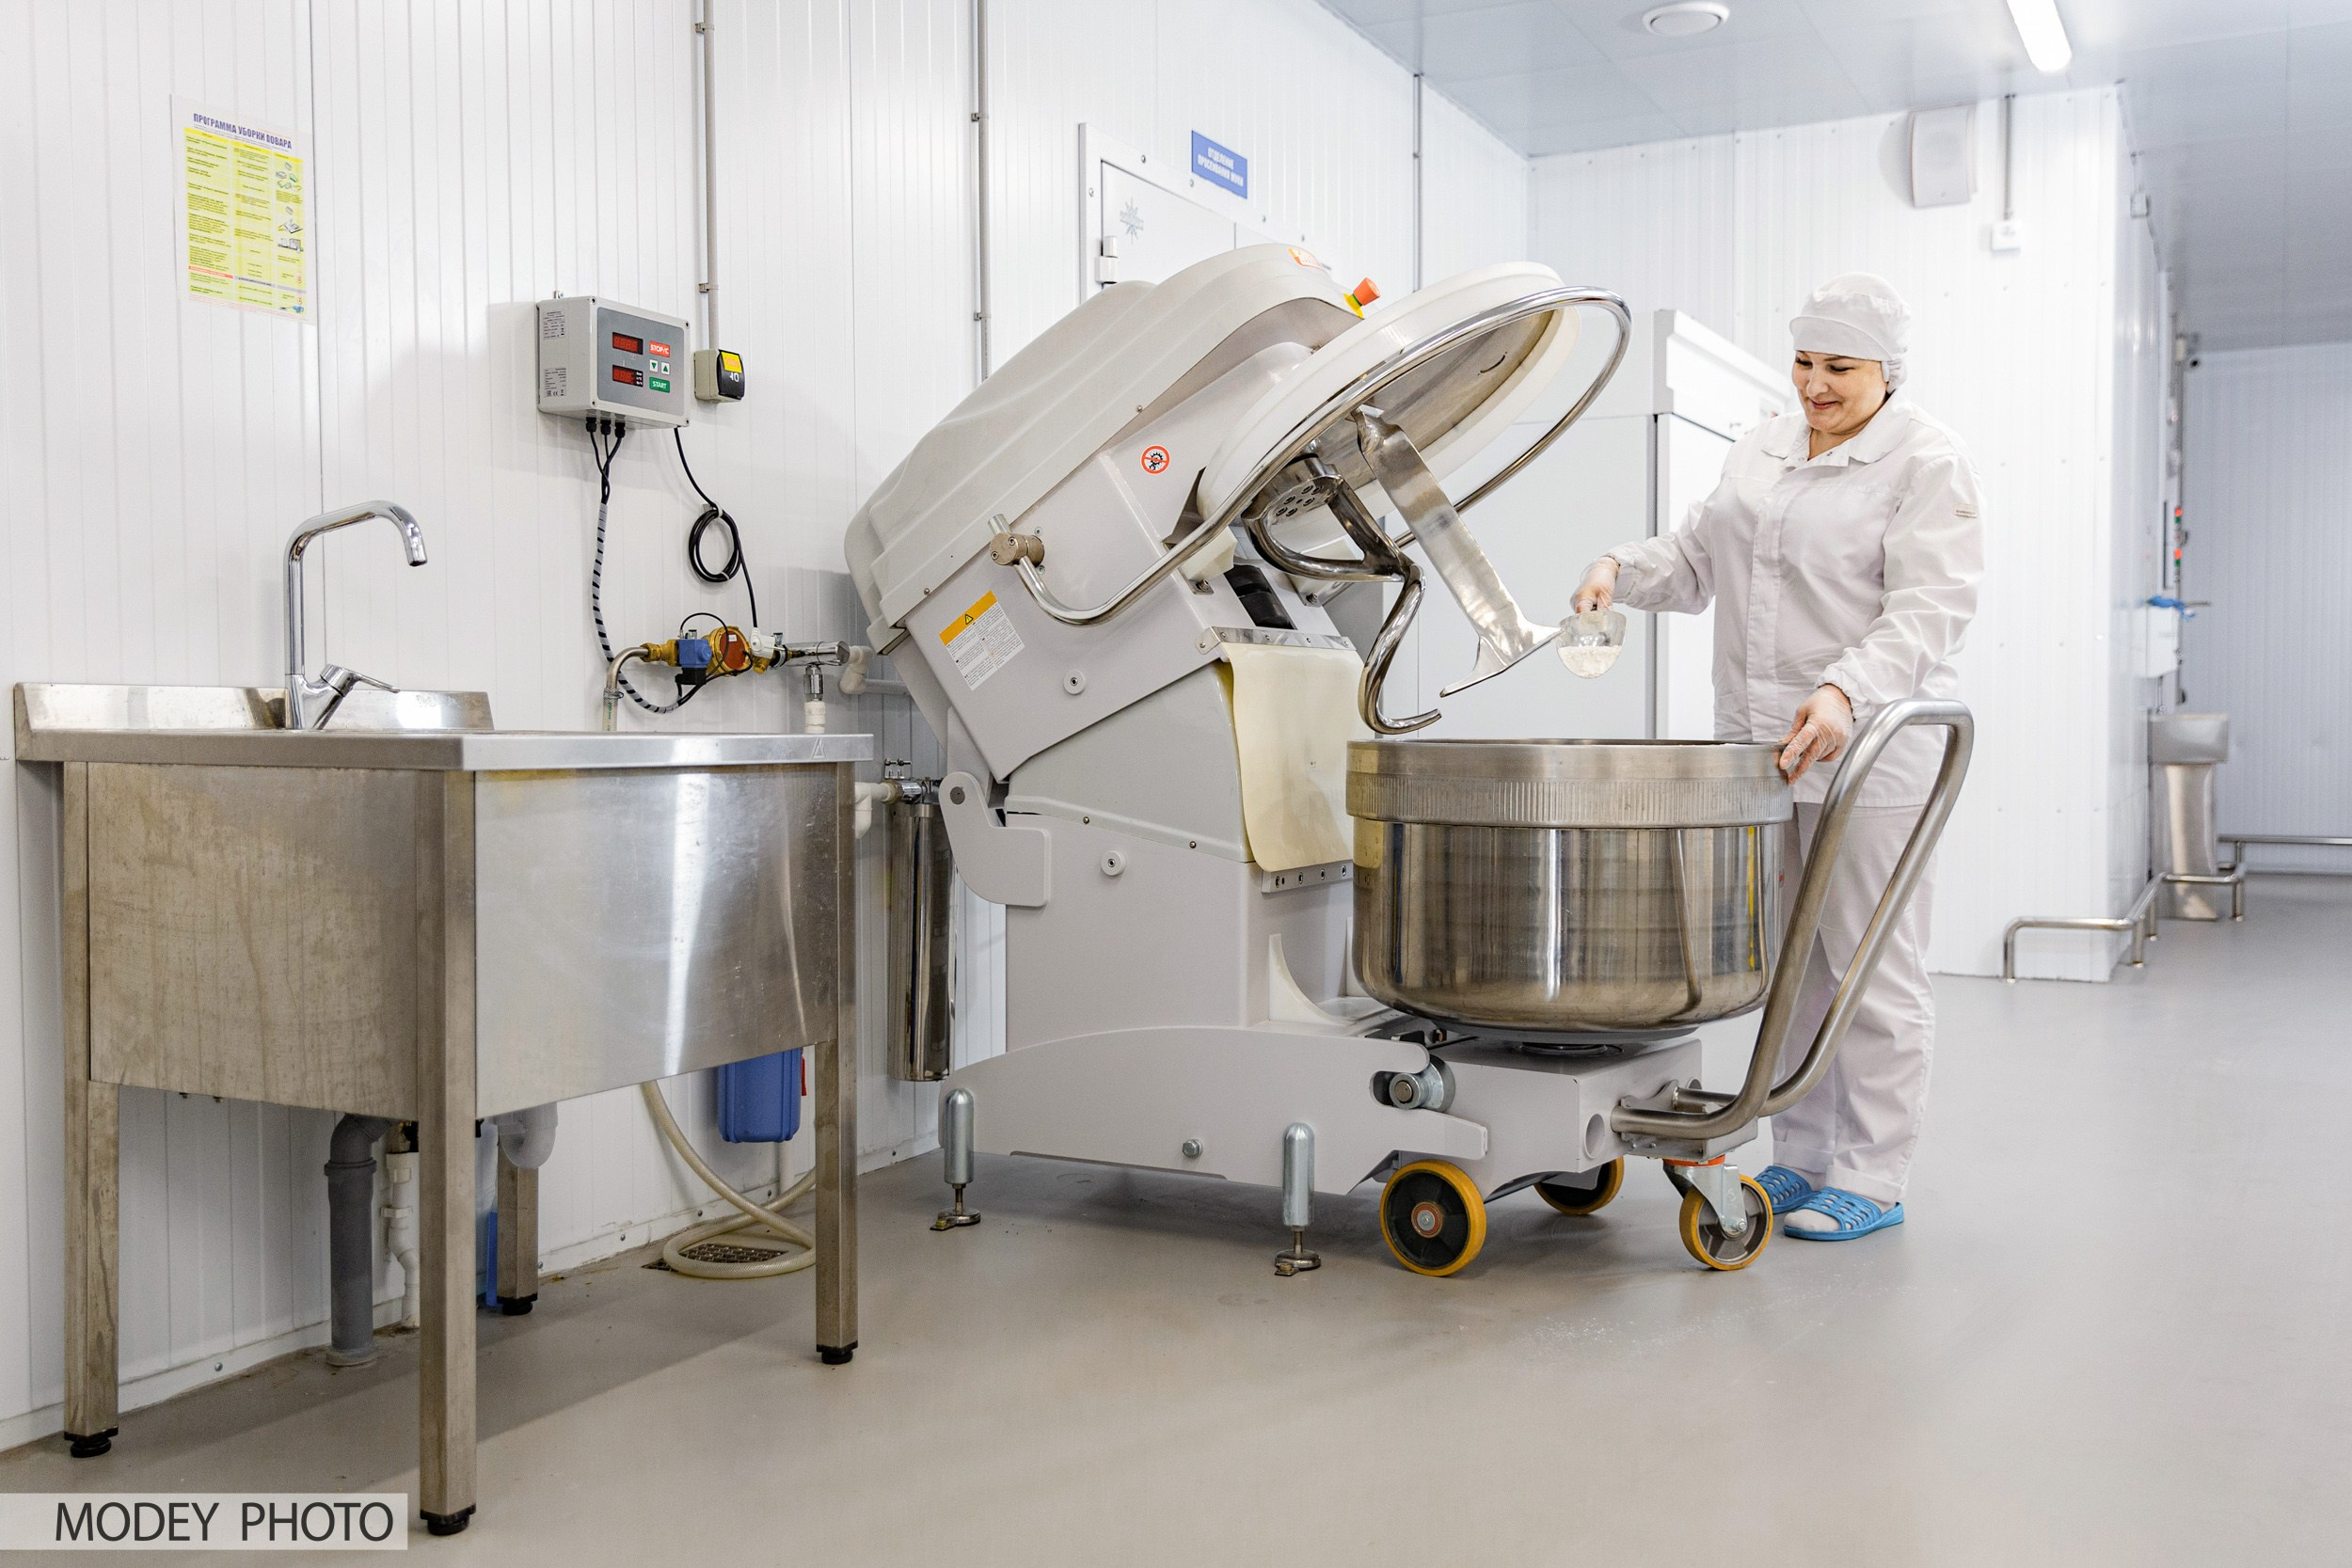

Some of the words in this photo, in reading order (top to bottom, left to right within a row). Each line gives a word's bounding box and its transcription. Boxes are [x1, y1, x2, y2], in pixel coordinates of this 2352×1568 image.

[193, 113, 237, 134] ПРОГРАММА
[238, 125, 265, 142] УБОРКИ
[650, 344, 669, 355] STOP/C
[652, 380, 667, 388] START
